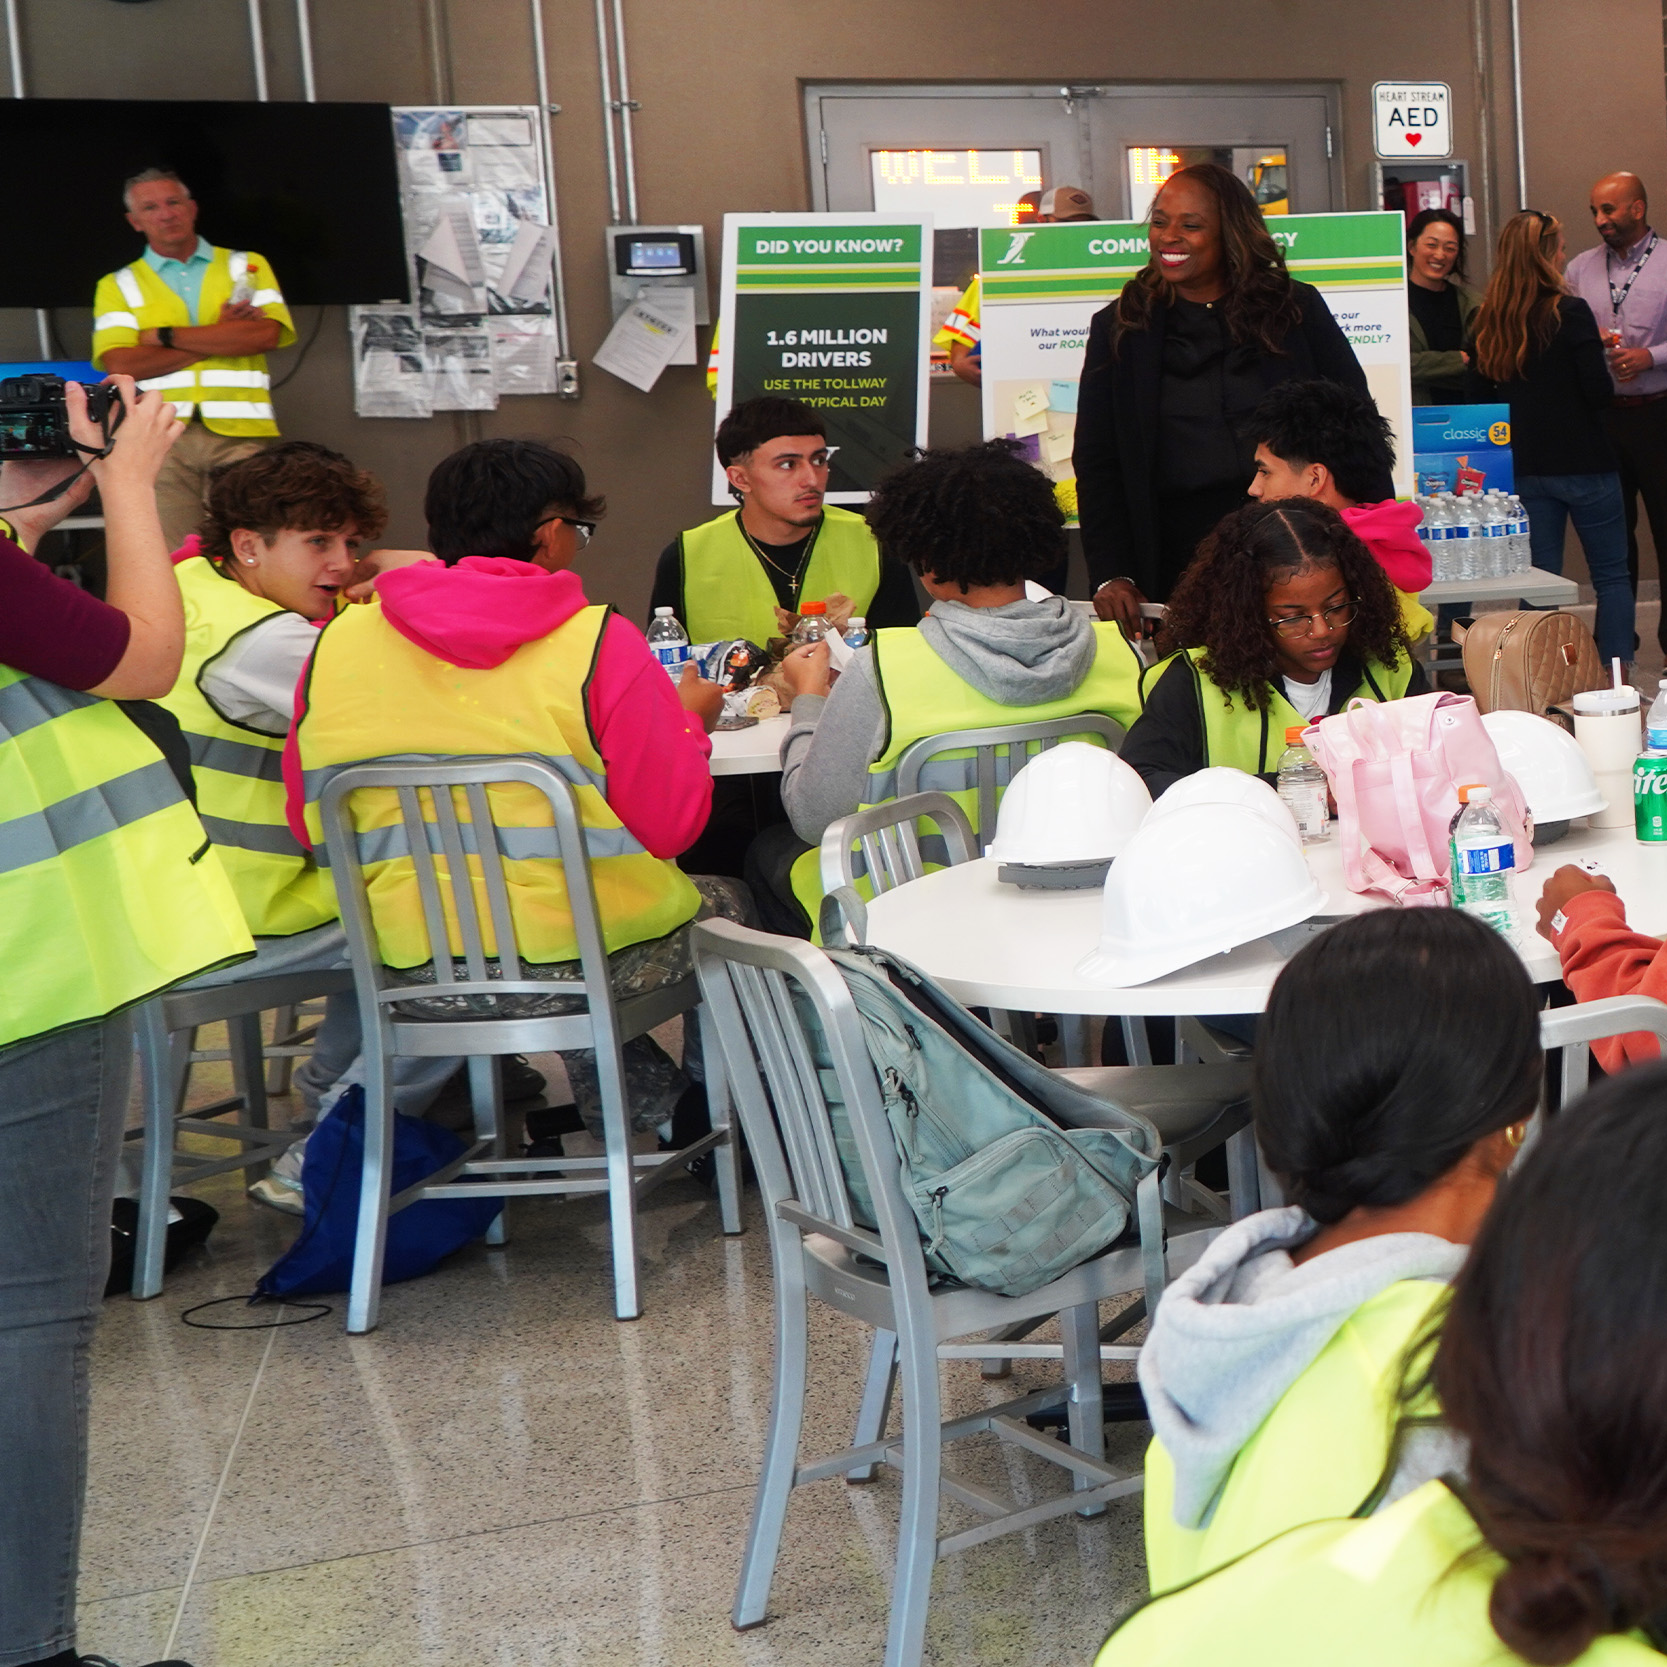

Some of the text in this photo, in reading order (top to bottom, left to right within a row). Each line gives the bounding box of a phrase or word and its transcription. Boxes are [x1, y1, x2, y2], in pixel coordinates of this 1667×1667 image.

[1379, 91, 1445, 103] HEART STREAM
[1388, 107, 1439, 127] AED
[755, 238, 904, 254] DID YOU KNOW?
[1341, 312, 1361, 320] our
[1030, 327, 1059, 339] What
[1353, 323, 1382, 332] more
[766, 328, 888, 346] 1.6 MILLION
[1038, 341, 1058, 350] our
[781, 350, 872, 368] DRIVERS
[764, 377, 888, 390] USE THE TOLLWAY
[859, 396, 888, 407] DAY
[1442, 425, 1507, 440] classic 54
